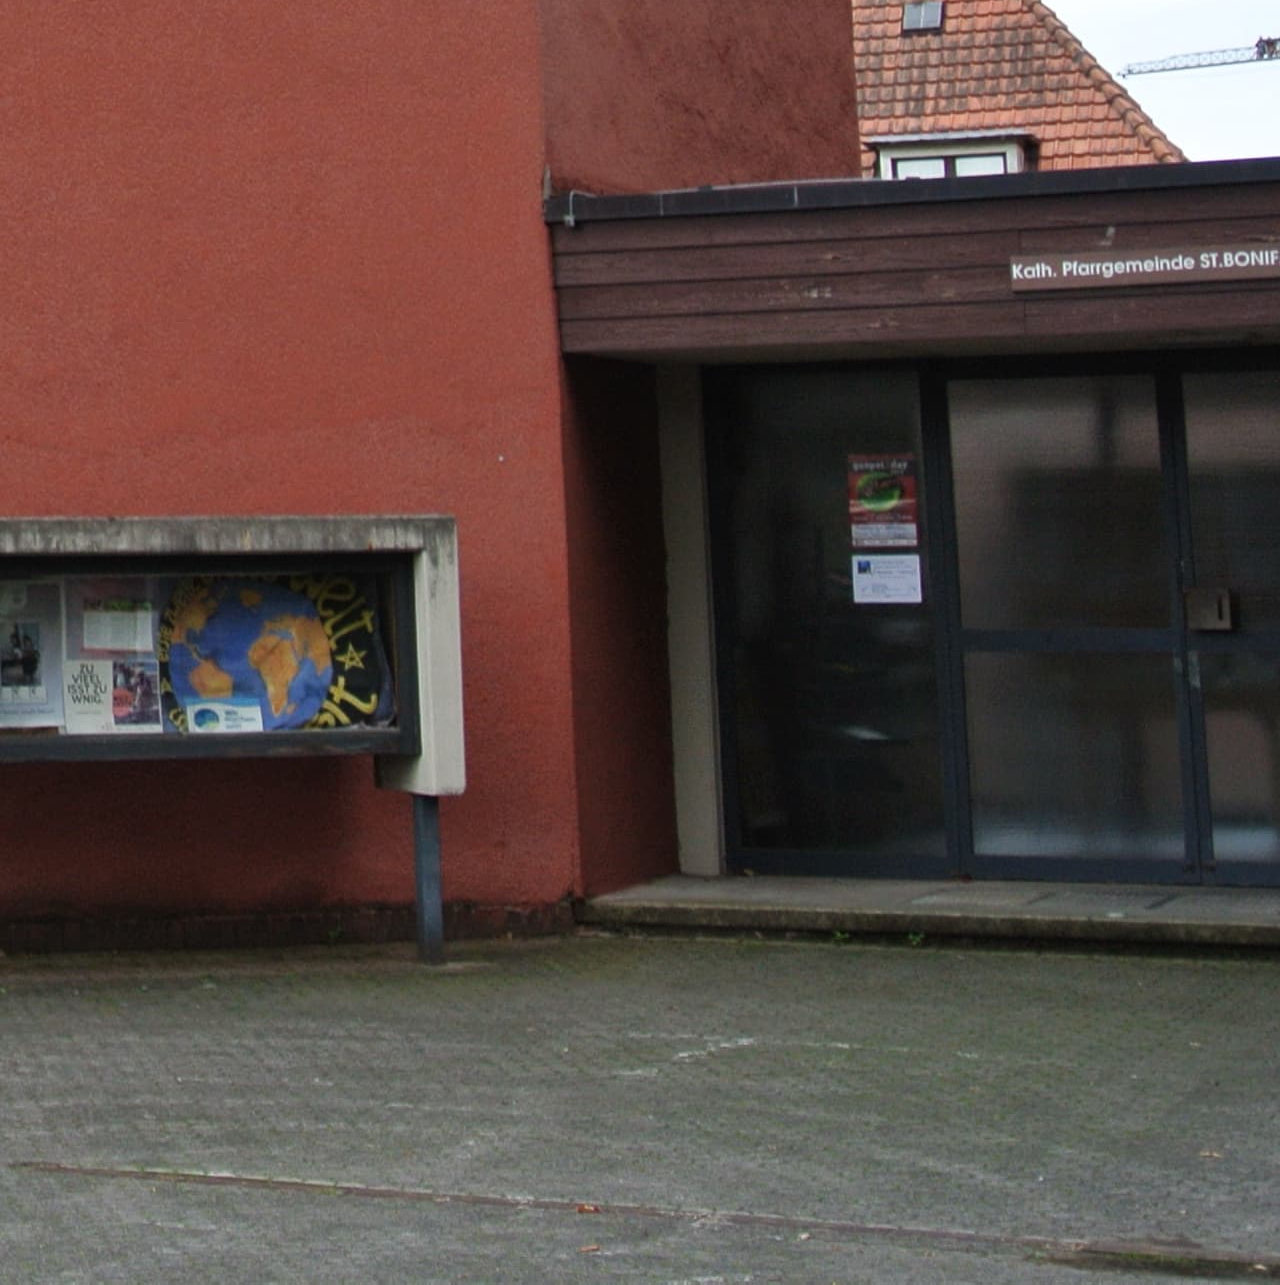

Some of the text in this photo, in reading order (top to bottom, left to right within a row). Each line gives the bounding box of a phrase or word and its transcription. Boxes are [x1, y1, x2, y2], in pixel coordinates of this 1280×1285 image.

[1012, 250, 1280, 280] Kath. Pfarrgemeinde ST.BONIF
[80, 663, 95, 675] ZU
[92, 682, 108, 695] ZU
